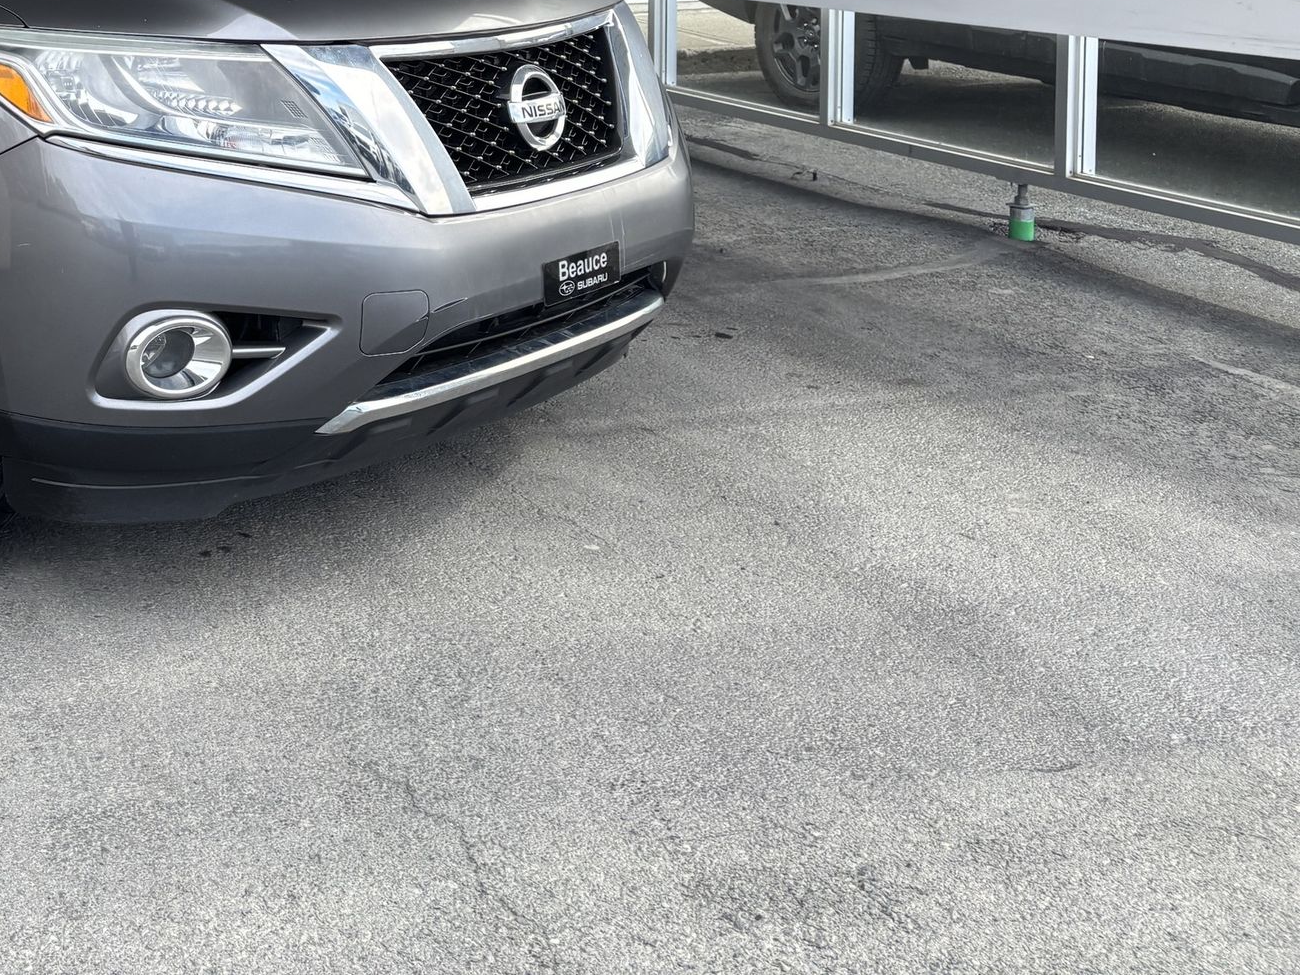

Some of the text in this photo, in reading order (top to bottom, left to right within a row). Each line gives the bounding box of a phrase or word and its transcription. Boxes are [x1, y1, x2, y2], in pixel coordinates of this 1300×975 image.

[521, 100, 565, 119] NISSAN
[558, 252, 608, 282] Beauce
[577, 272, 608, 290] SUBARU
